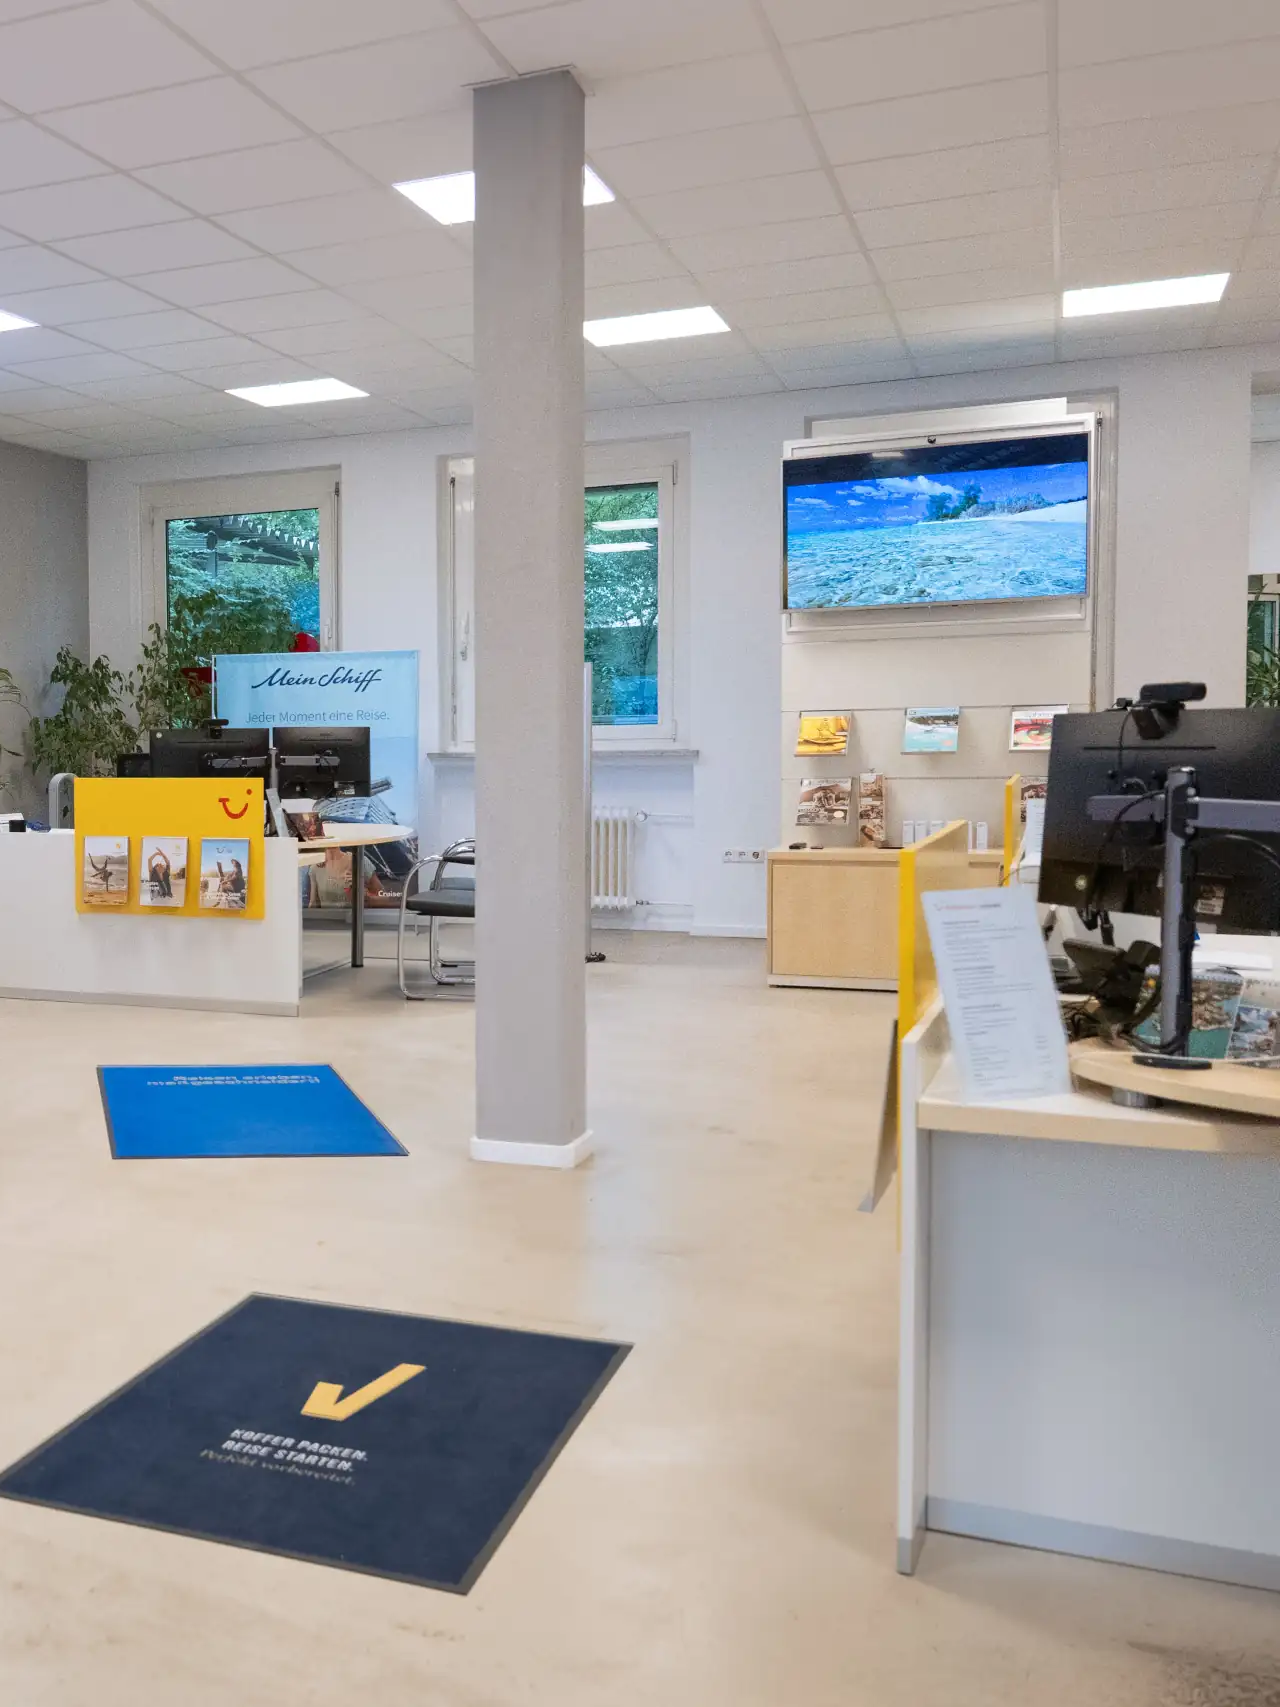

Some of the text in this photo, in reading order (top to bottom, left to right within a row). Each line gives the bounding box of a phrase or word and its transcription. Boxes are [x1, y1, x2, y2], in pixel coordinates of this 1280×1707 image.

[251, 666, 382, 692] Mein Schiff
[245, 709, 390, 723] Jeder Moment eine Reise.
[221, 1439, 355, 1472] REISE STARTEN.
[230, 1428, 368, 1462] KOFFER PACKEN.
